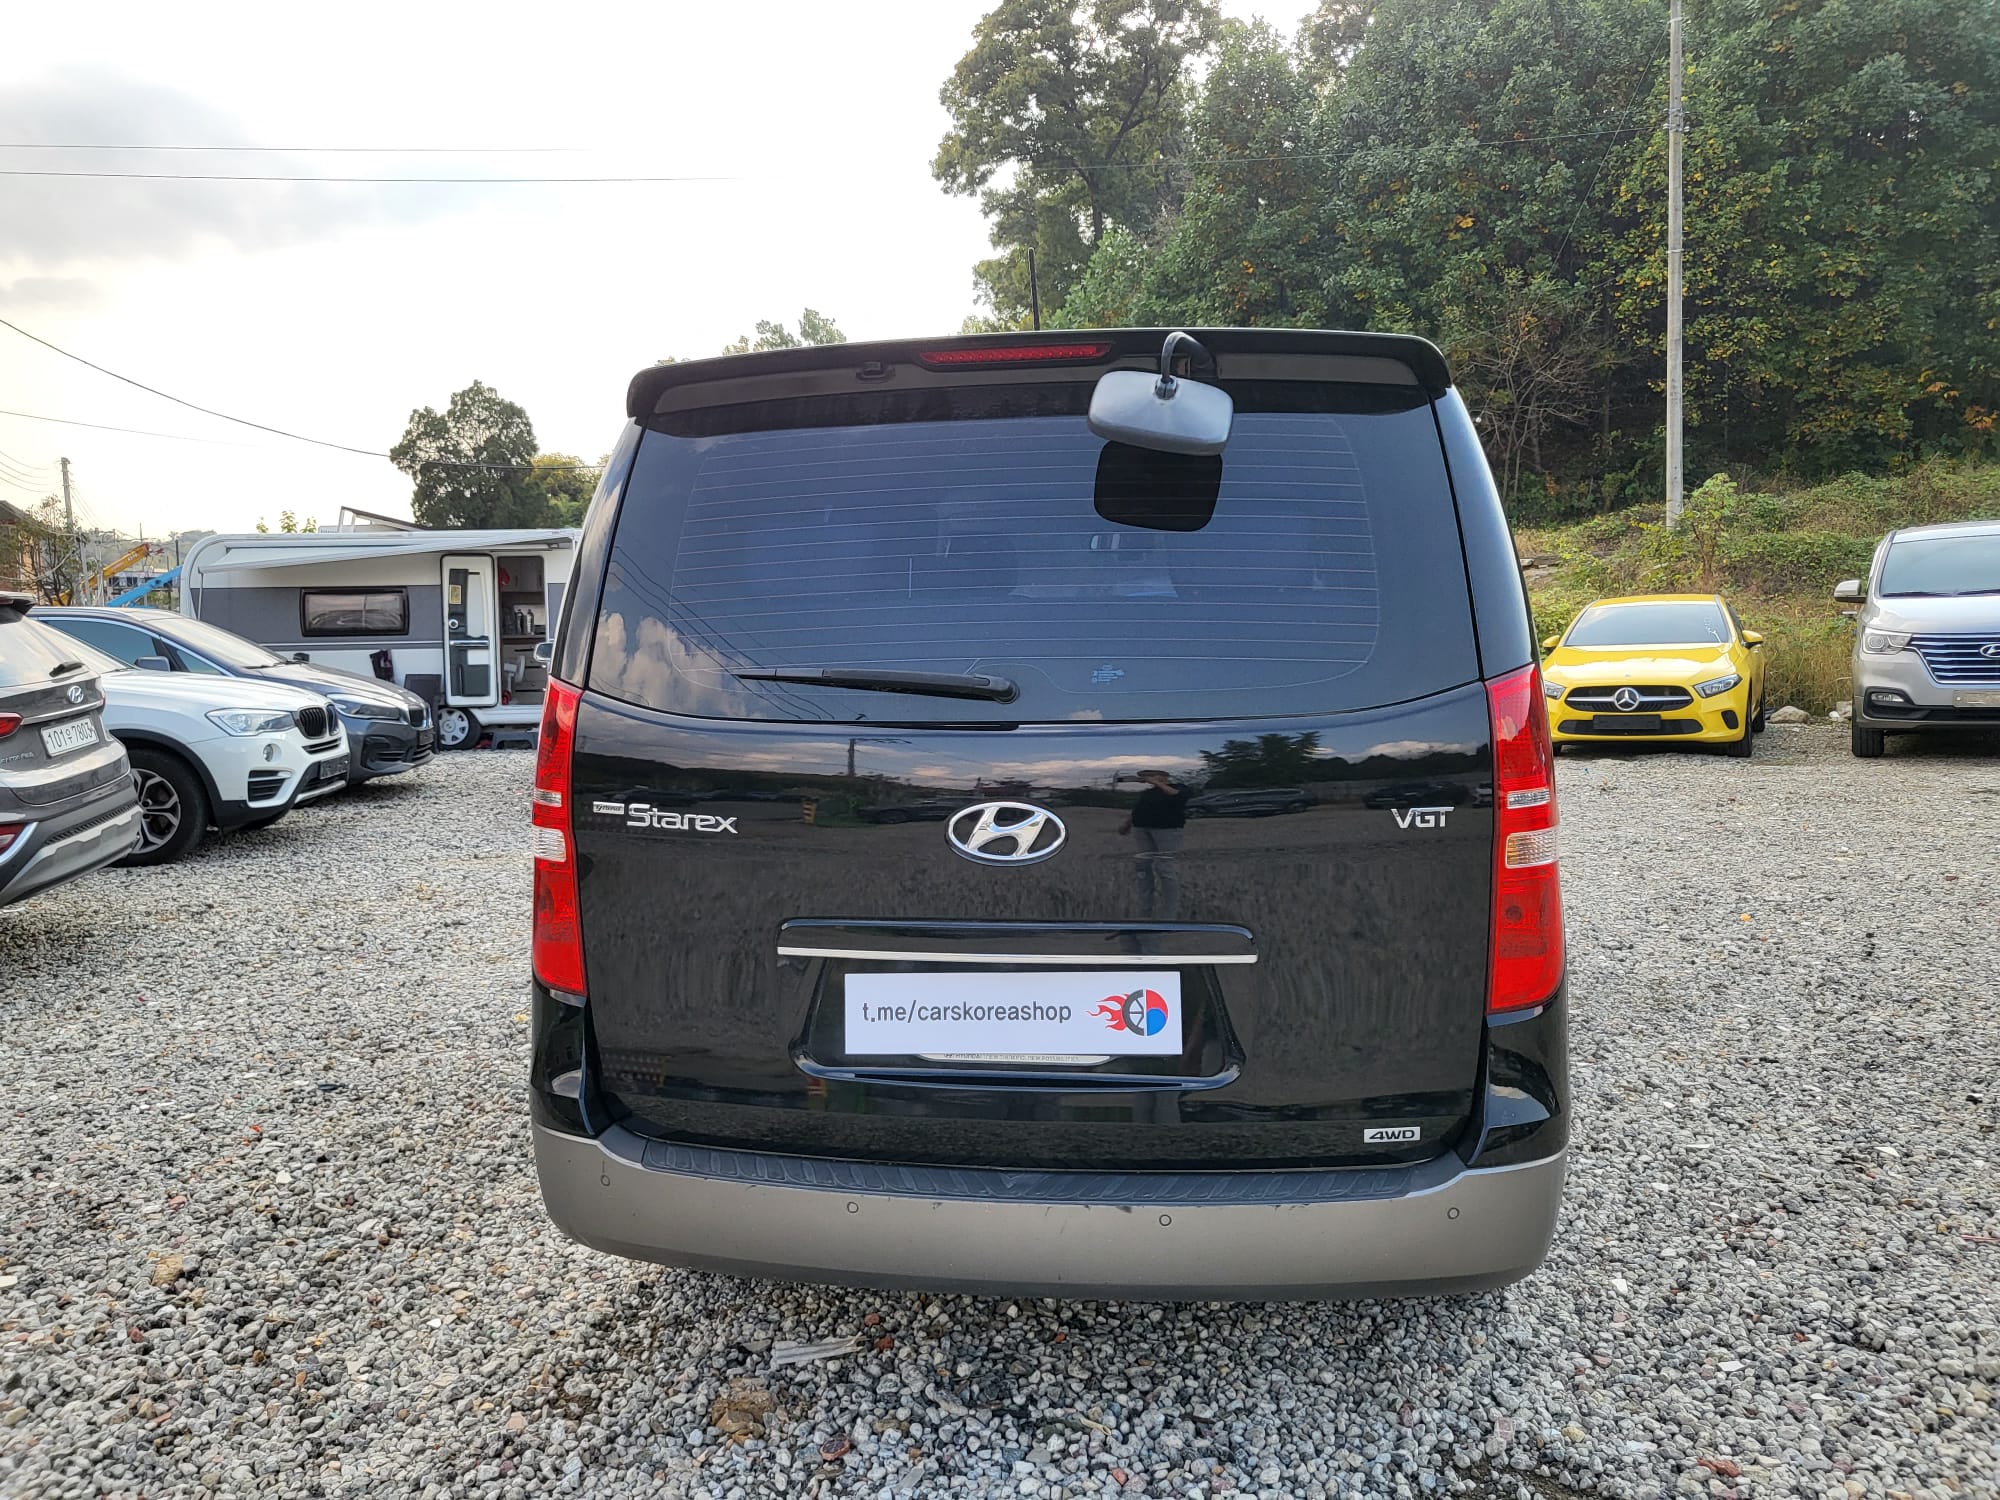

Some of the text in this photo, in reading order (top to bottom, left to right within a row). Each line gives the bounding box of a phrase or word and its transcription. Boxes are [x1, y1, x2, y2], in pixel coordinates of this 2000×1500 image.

[627, 803, 738, 834] Starex
[1390, 806, 1455, 829] VGT
[1368, 1129, 1415, 1140] 4WD
